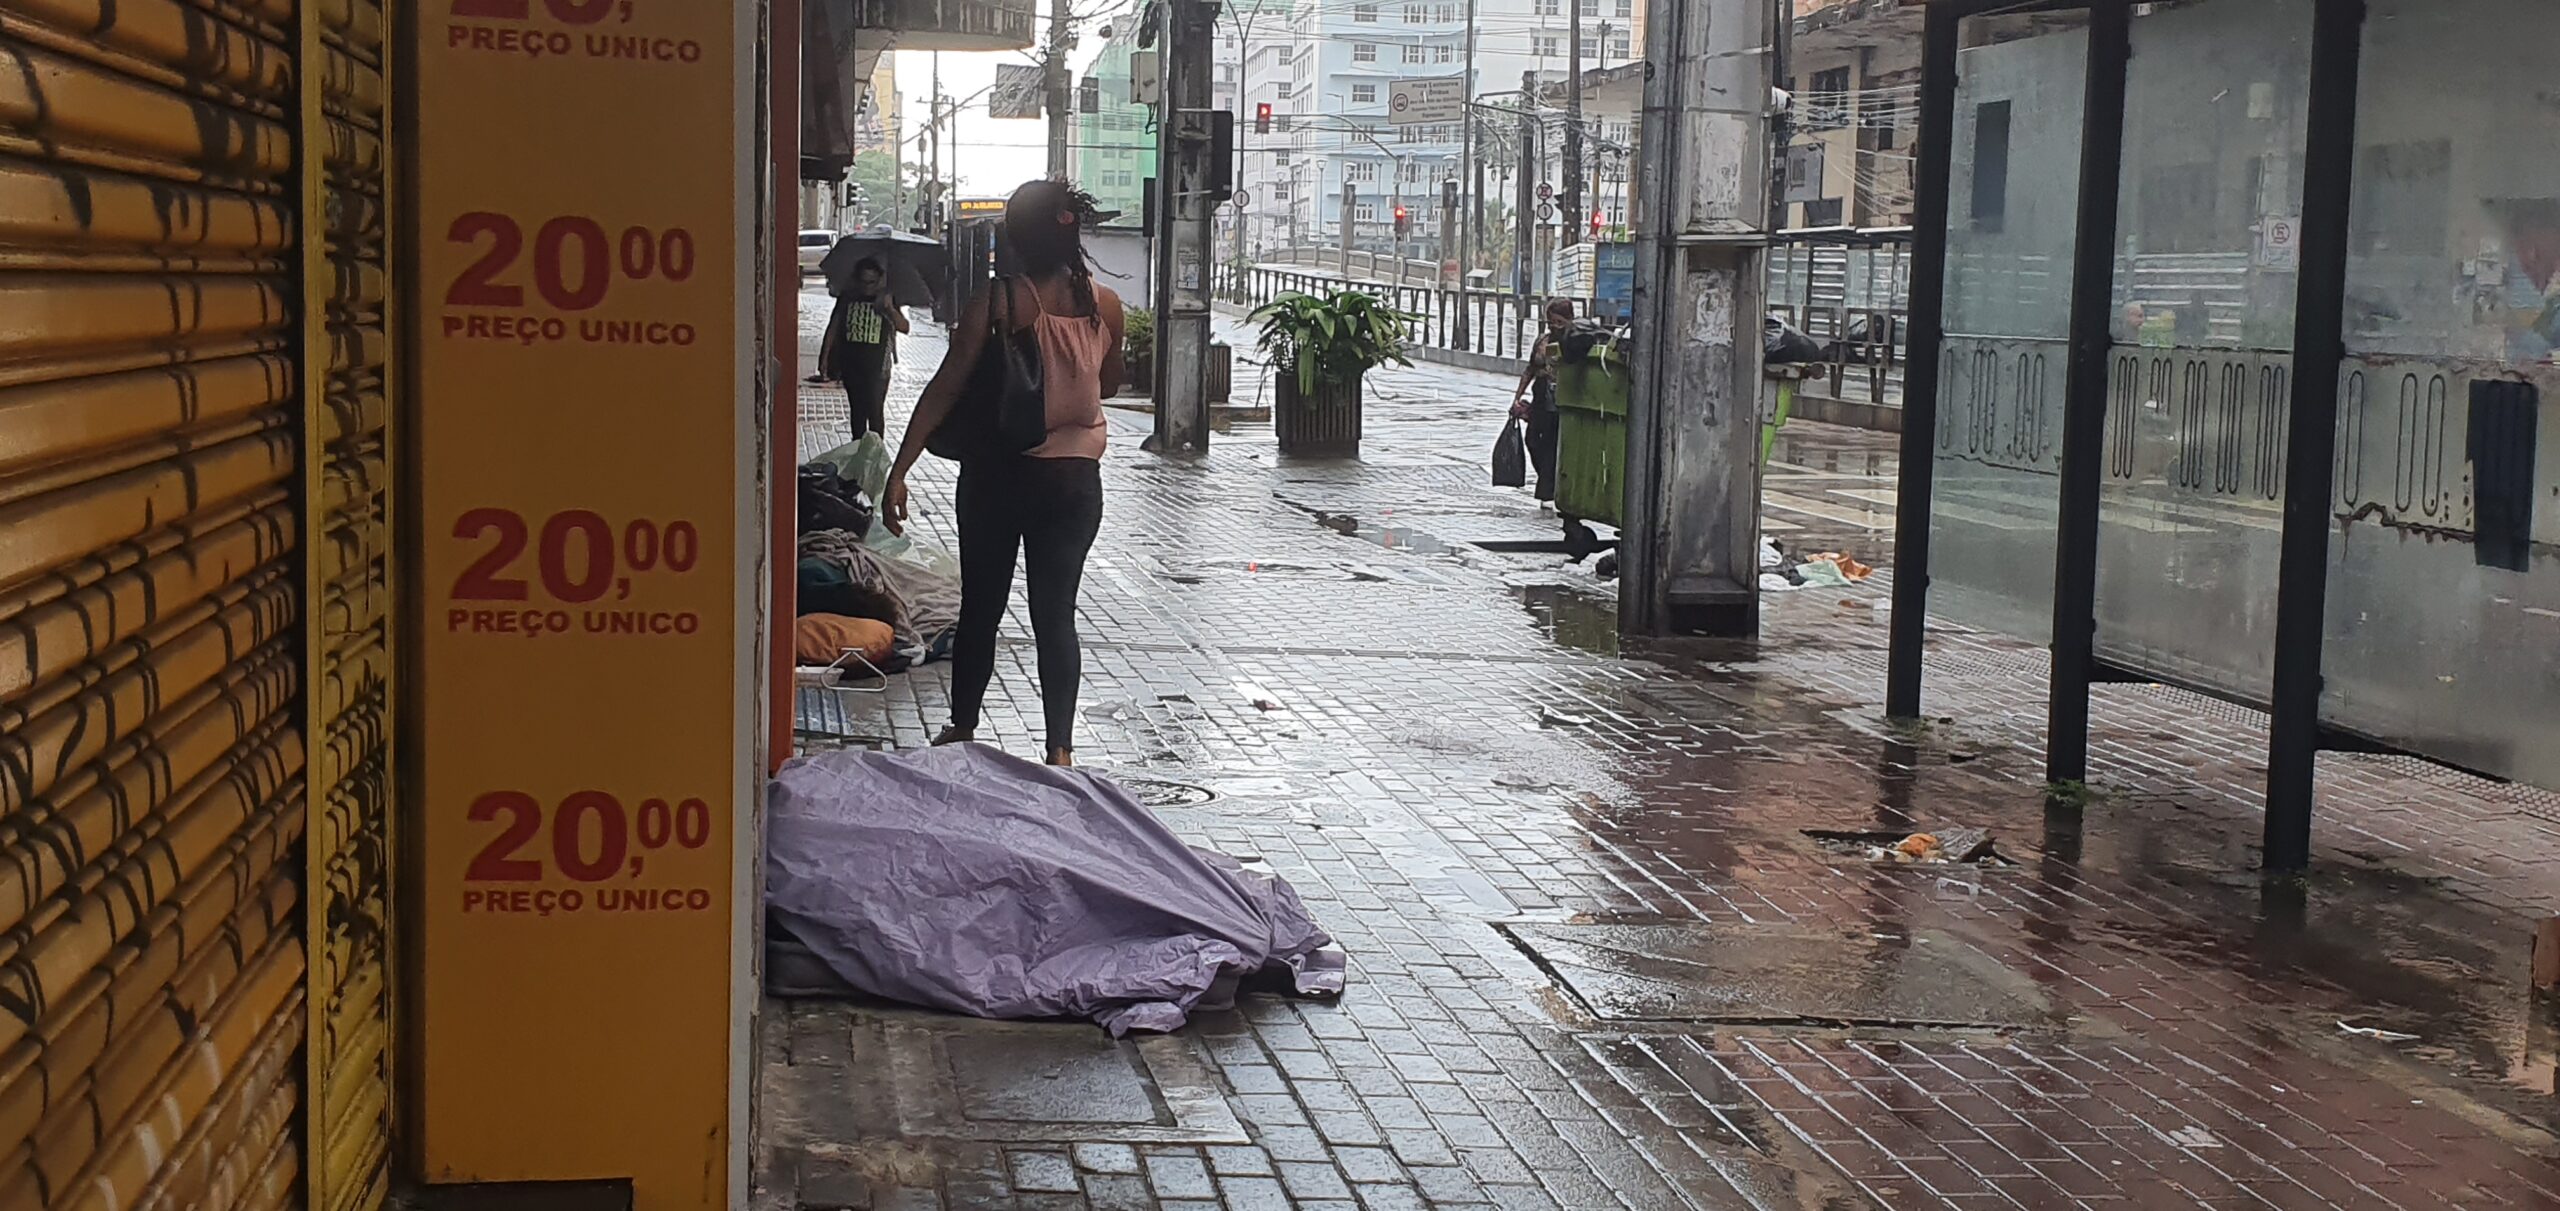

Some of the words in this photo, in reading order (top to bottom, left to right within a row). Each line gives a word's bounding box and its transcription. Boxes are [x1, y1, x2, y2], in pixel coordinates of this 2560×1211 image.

[448, 25, 572, 57] PREÇO
[585, 34, 700, 63] UNICO
[441, 315, 566, 345] PREÇO
[579, 320, 696, 346] UNICO
[448, 609, 570, 637] PREÇO
[583, 611, 698, 634] UNICO
[462, 889, 583, 916] PREÇO
[596, 888, 711, 911] UNICO
